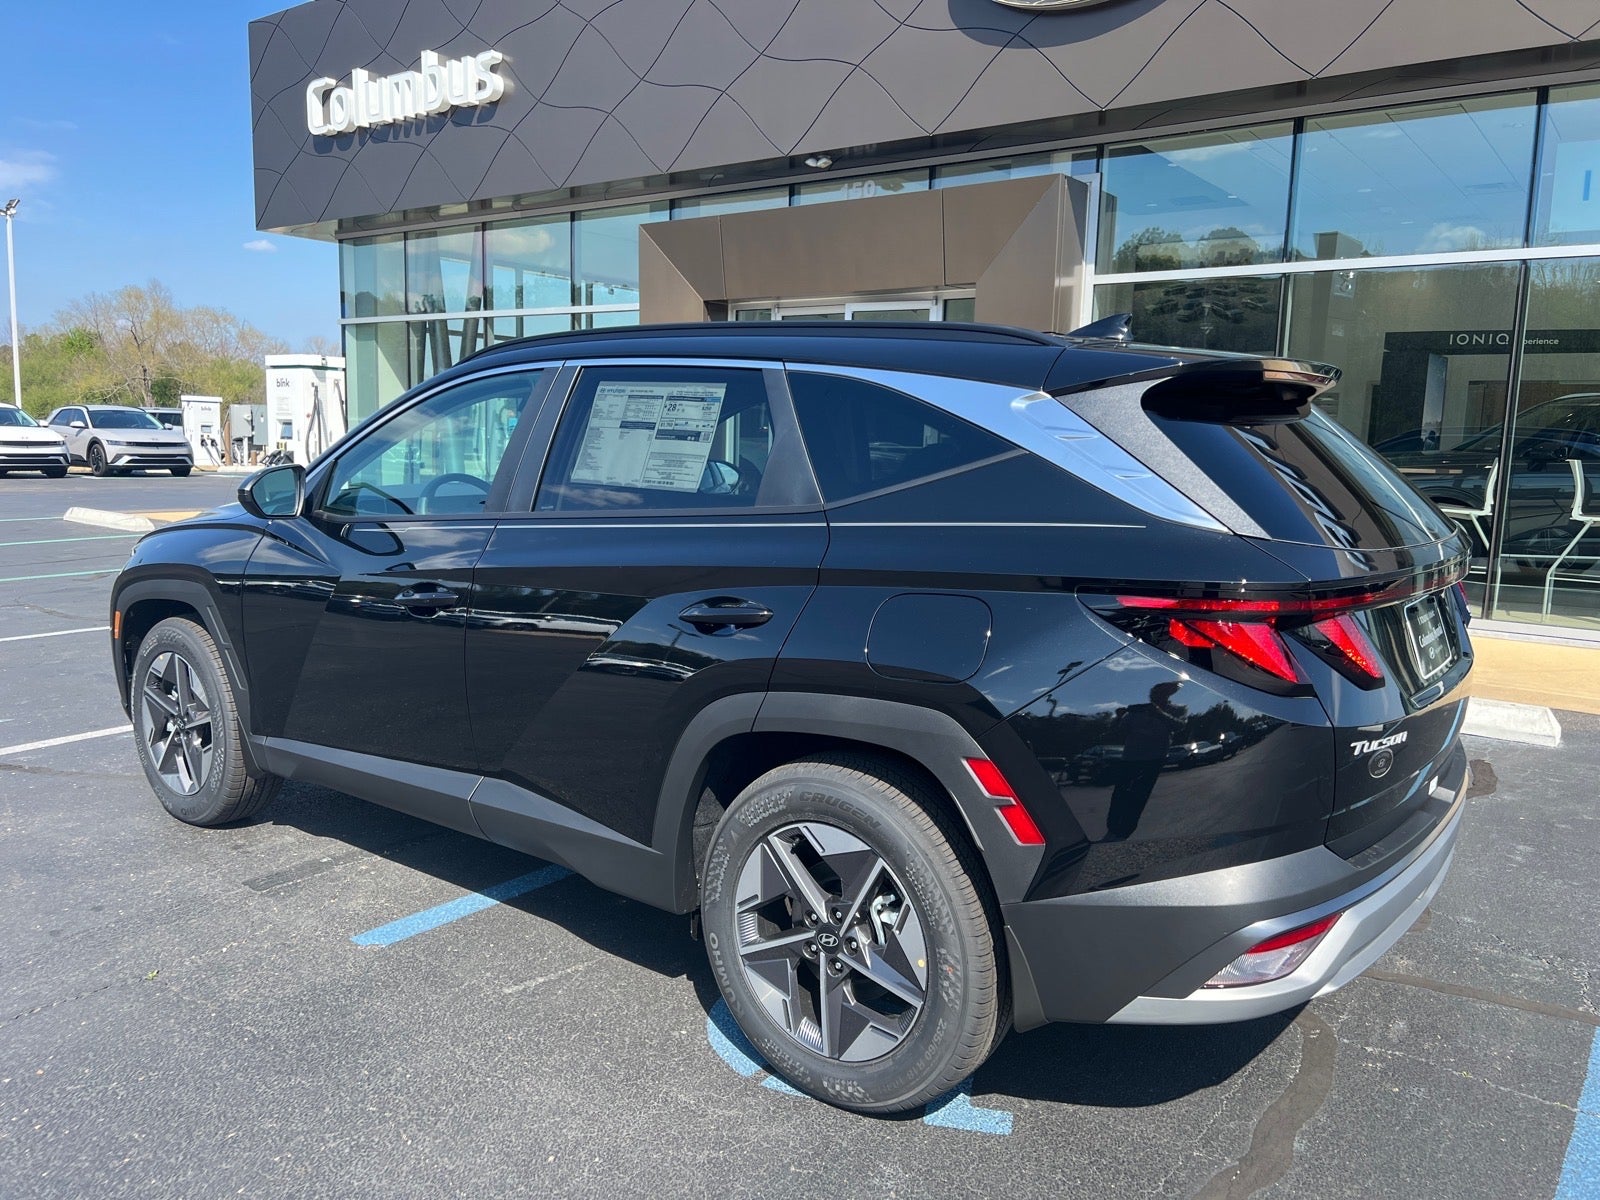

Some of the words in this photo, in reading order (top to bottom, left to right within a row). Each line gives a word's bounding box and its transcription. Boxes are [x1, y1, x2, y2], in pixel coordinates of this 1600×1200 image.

[306, 49, 505, 137] Columbus
[841, 180, 876, 199] 150
[1449, 333, 1510, 346] IONIQ
[276, 378, 290, 387] blink
[667, 403, 677, 412] 28
[799, 791, 882, 829] CRUGEN
